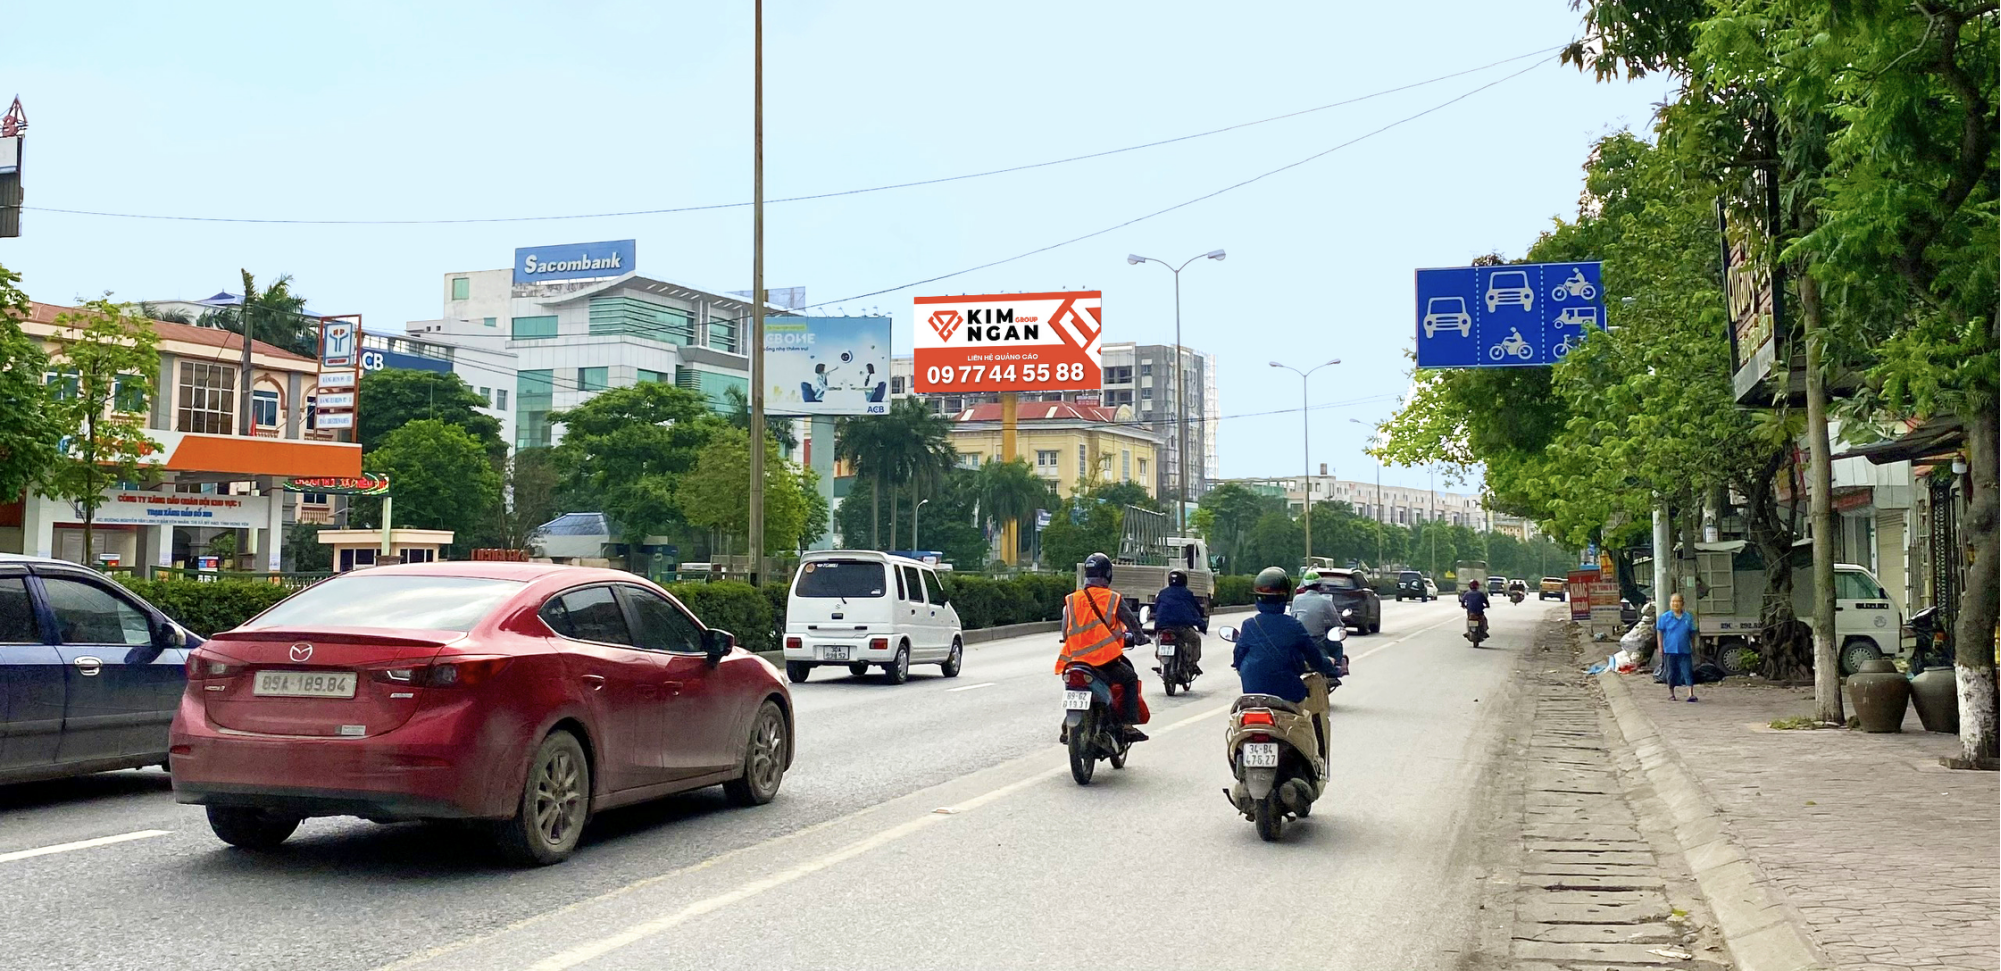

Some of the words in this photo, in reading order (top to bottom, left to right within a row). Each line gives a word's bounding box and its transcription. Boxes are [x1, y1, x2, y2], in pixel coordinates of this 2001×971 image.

[524, 251, 622, 274] Sacombank
[967, 308, 1014, 325] KIM
[967, 324, 1039, 342] NGAN
[360, 351, 384, 371] CB
[967, 353, 983, 362] LIÊN
[983, 353, 994, 362] HỆ
[994, 352, 1021, 361] QUẢNG
[1021, 352, 1039, 361] CÁO
[927, 365, 955, 385] 09
[1022, 363, 1050, 382] 55
[1055, 362, 1085, 382] 88
[867, 405, 885, 413] ACB
